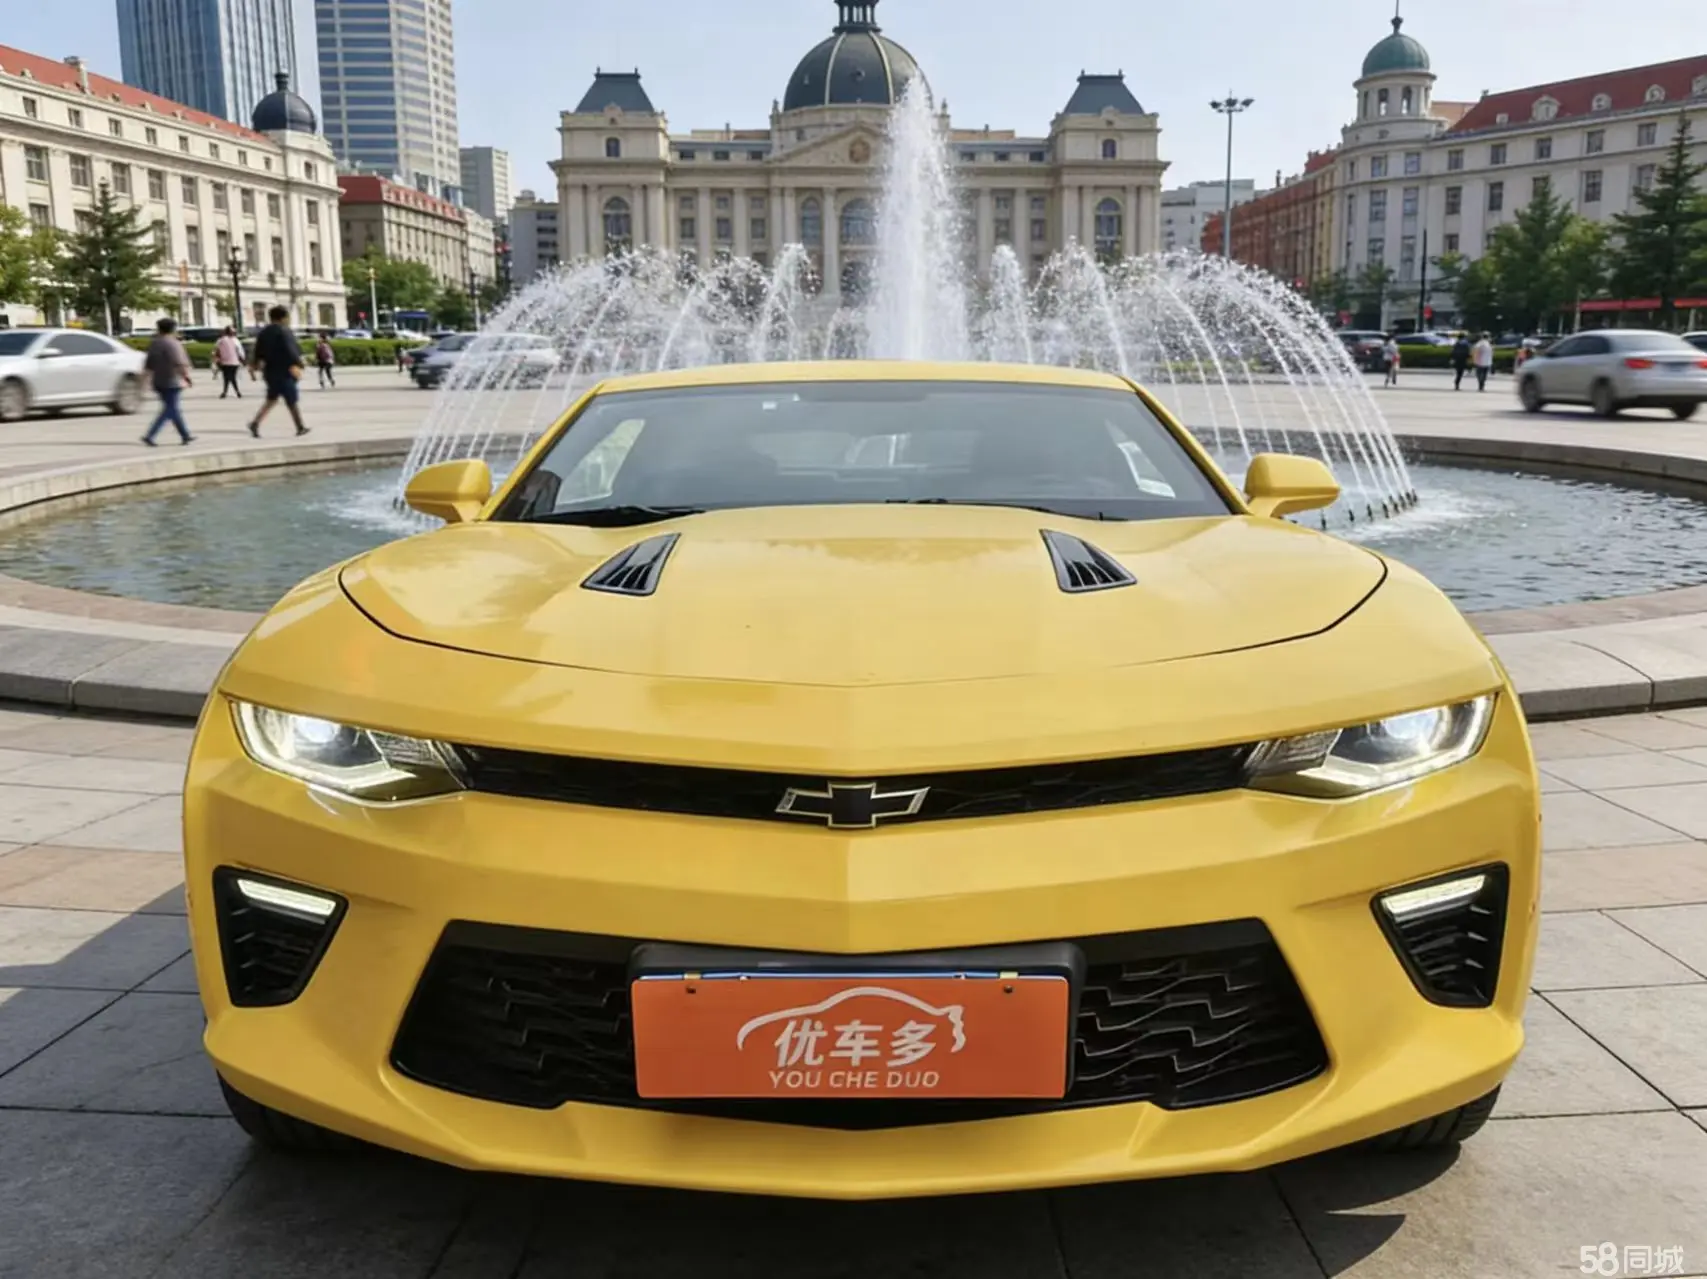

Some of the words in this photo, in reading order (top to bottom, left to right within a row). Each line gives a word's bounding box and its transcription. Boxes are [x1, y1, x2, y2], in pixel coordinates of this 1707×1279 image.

[774, 1019, 937, 1068] 优车多
[769, 1071, 821, 1089] YOU
[829, 1071, 880, 1089] CHE
[886, 1071, 940, 1089] DUO
